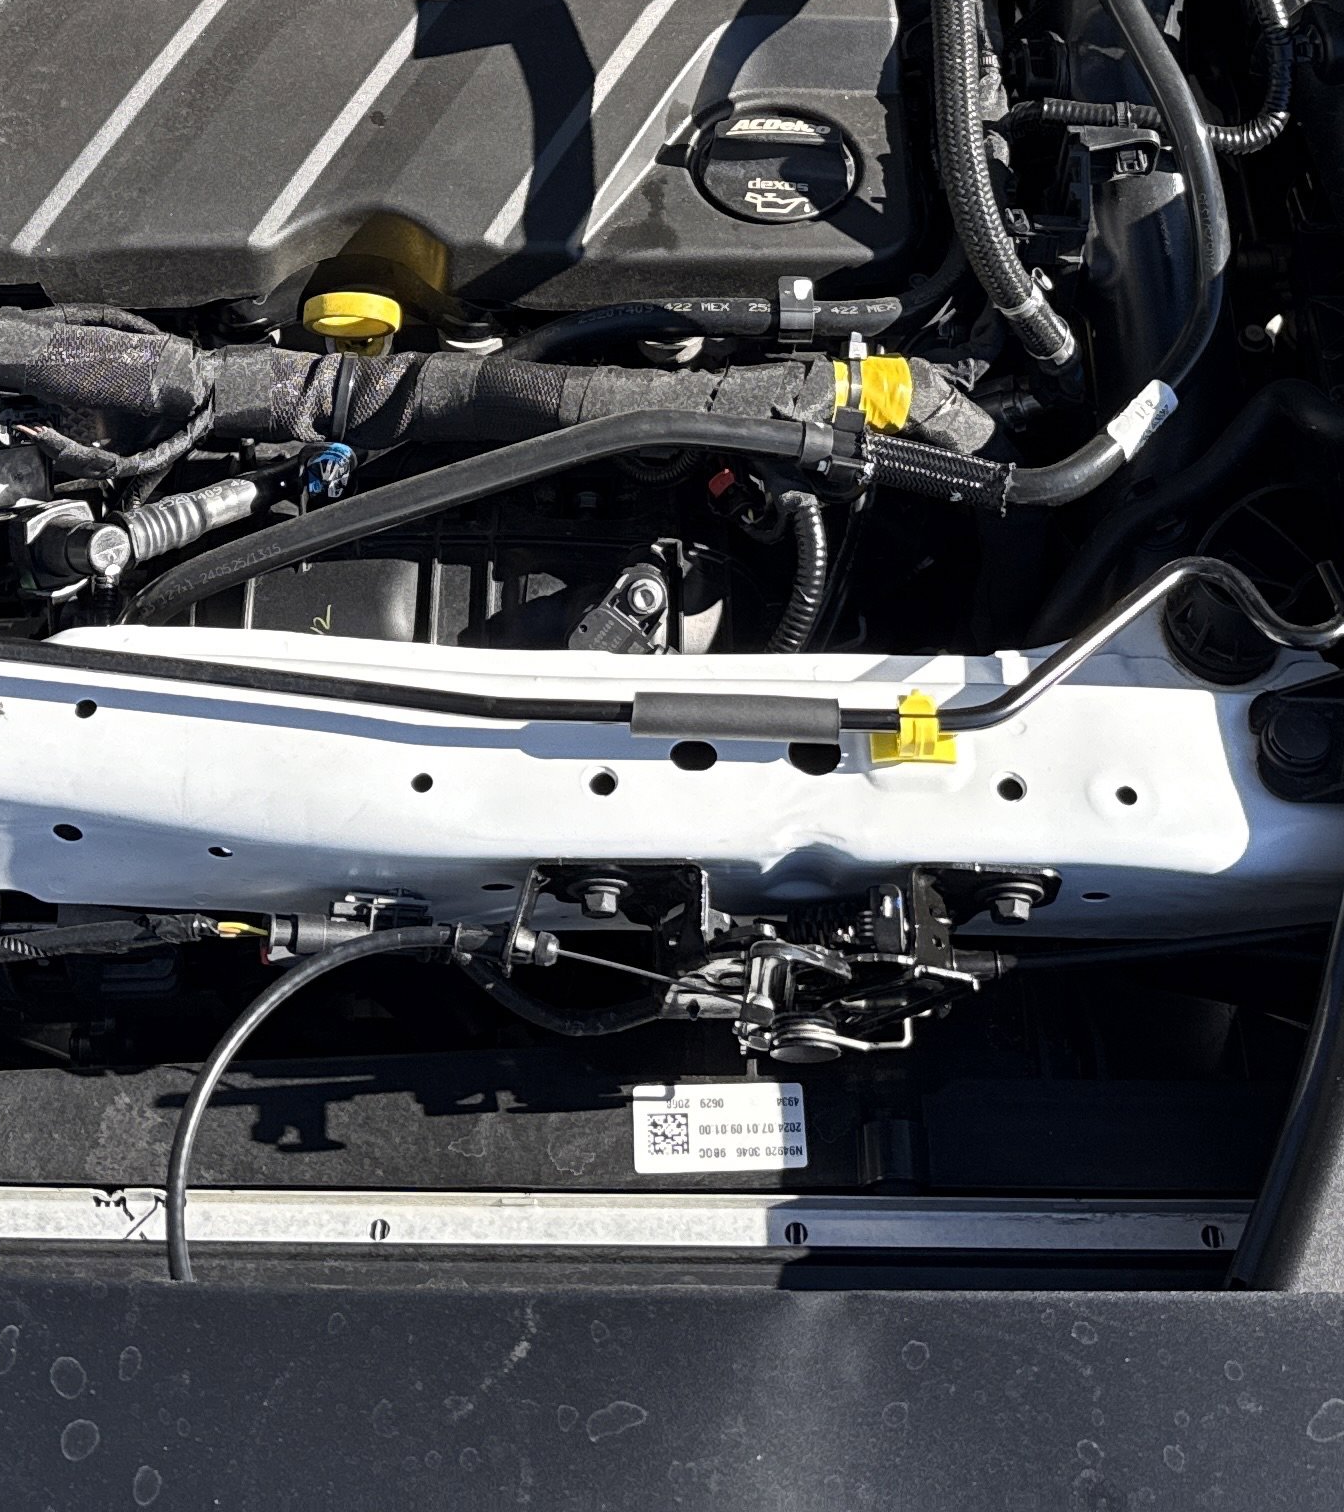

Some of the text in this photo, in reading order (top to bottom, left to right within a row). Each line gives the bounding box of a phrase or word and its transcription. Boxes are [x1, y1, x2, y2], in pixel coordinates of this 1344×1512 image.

[731, 118, 831, 135] ACDelco
[664, 302, 692, 312] 422
[700, 302, 730, 312] MEX
[830, 305, 859, 315] 422
[867, 303, 897, 314] MEX
